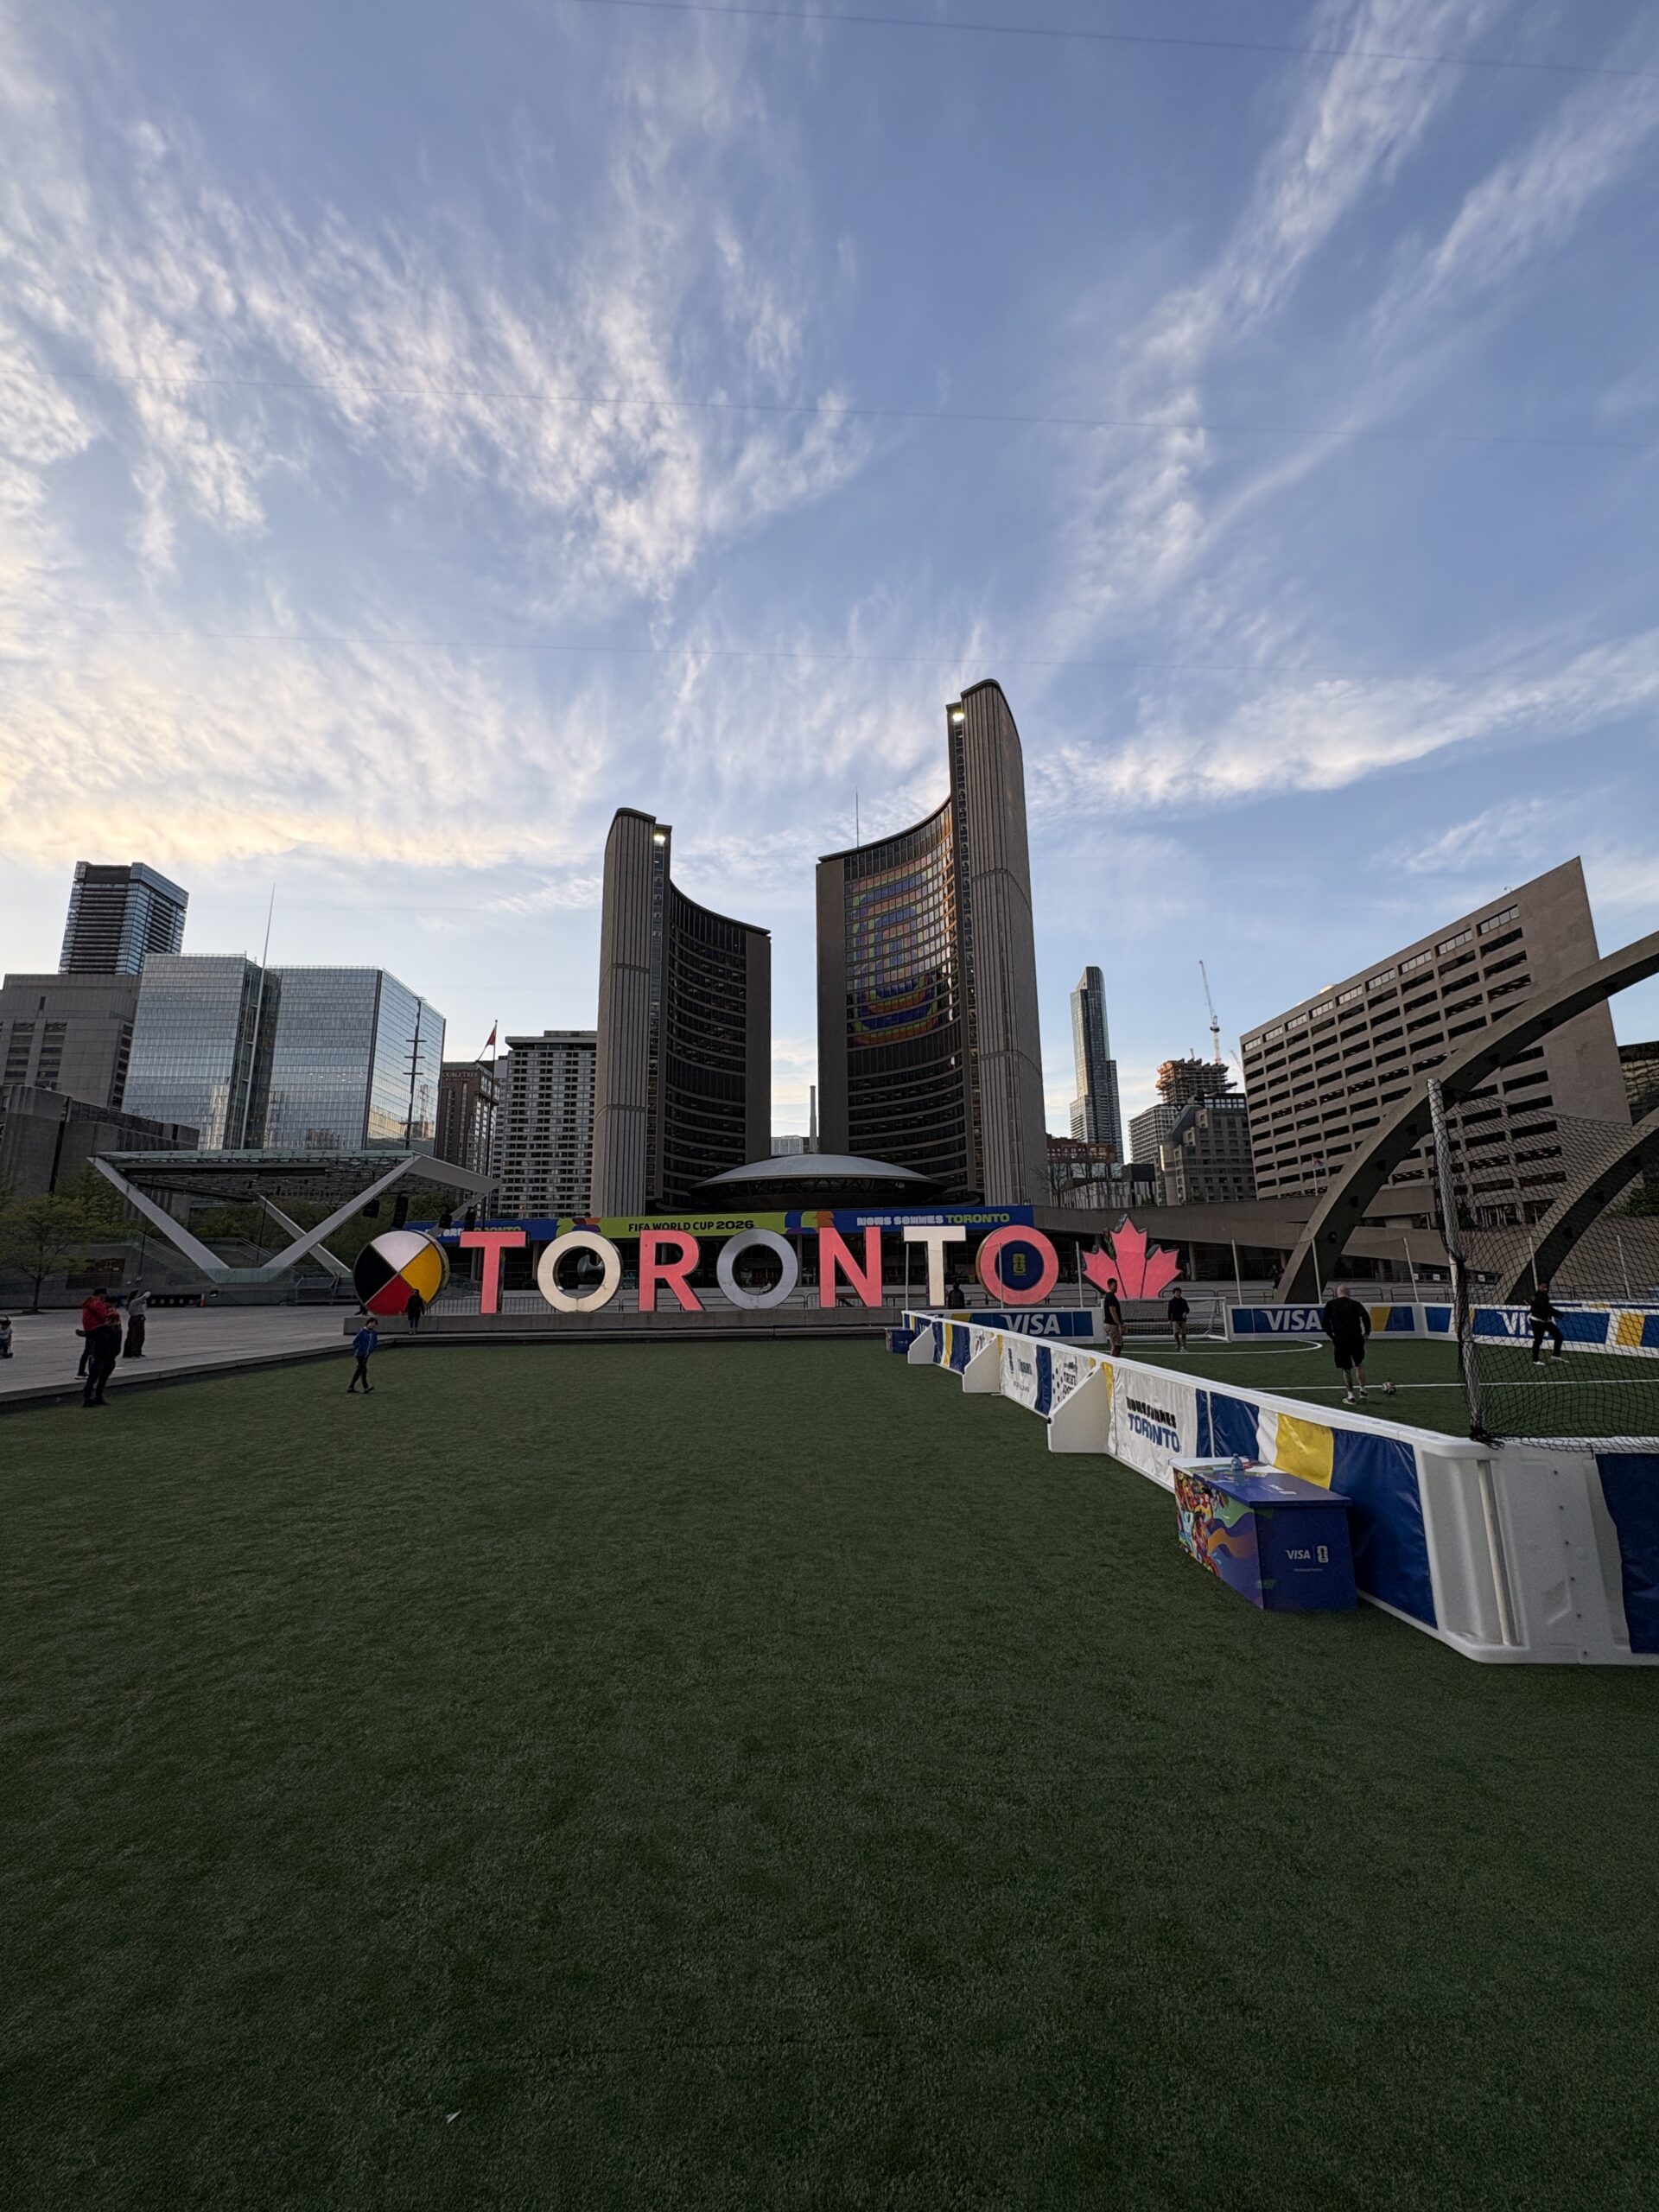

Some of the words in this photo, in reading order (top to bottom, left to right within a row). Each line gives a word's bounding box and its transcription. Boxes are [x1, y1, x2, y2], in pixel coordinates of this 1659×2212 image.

[628, 1223, 652, 1232] FIFA
[652, 1222, 691, 1230] WORLD
[693, 1221, 715, 1230] CUP
[716, 1220, 754, 1230] 2026
[856, 1217, 892, 1226] NOUS
[893, 1215, 944, 1225] SOMMES
[945, 1213, 1010, 1224] TORONTO
[459, 1224, 1059, 1314] TORONTO
[1001, 1314, 1061, 1335] VISA
[1261, 1309, 1323, 1332] VISA
[1285, 1549, 1311, 1560] VISA
